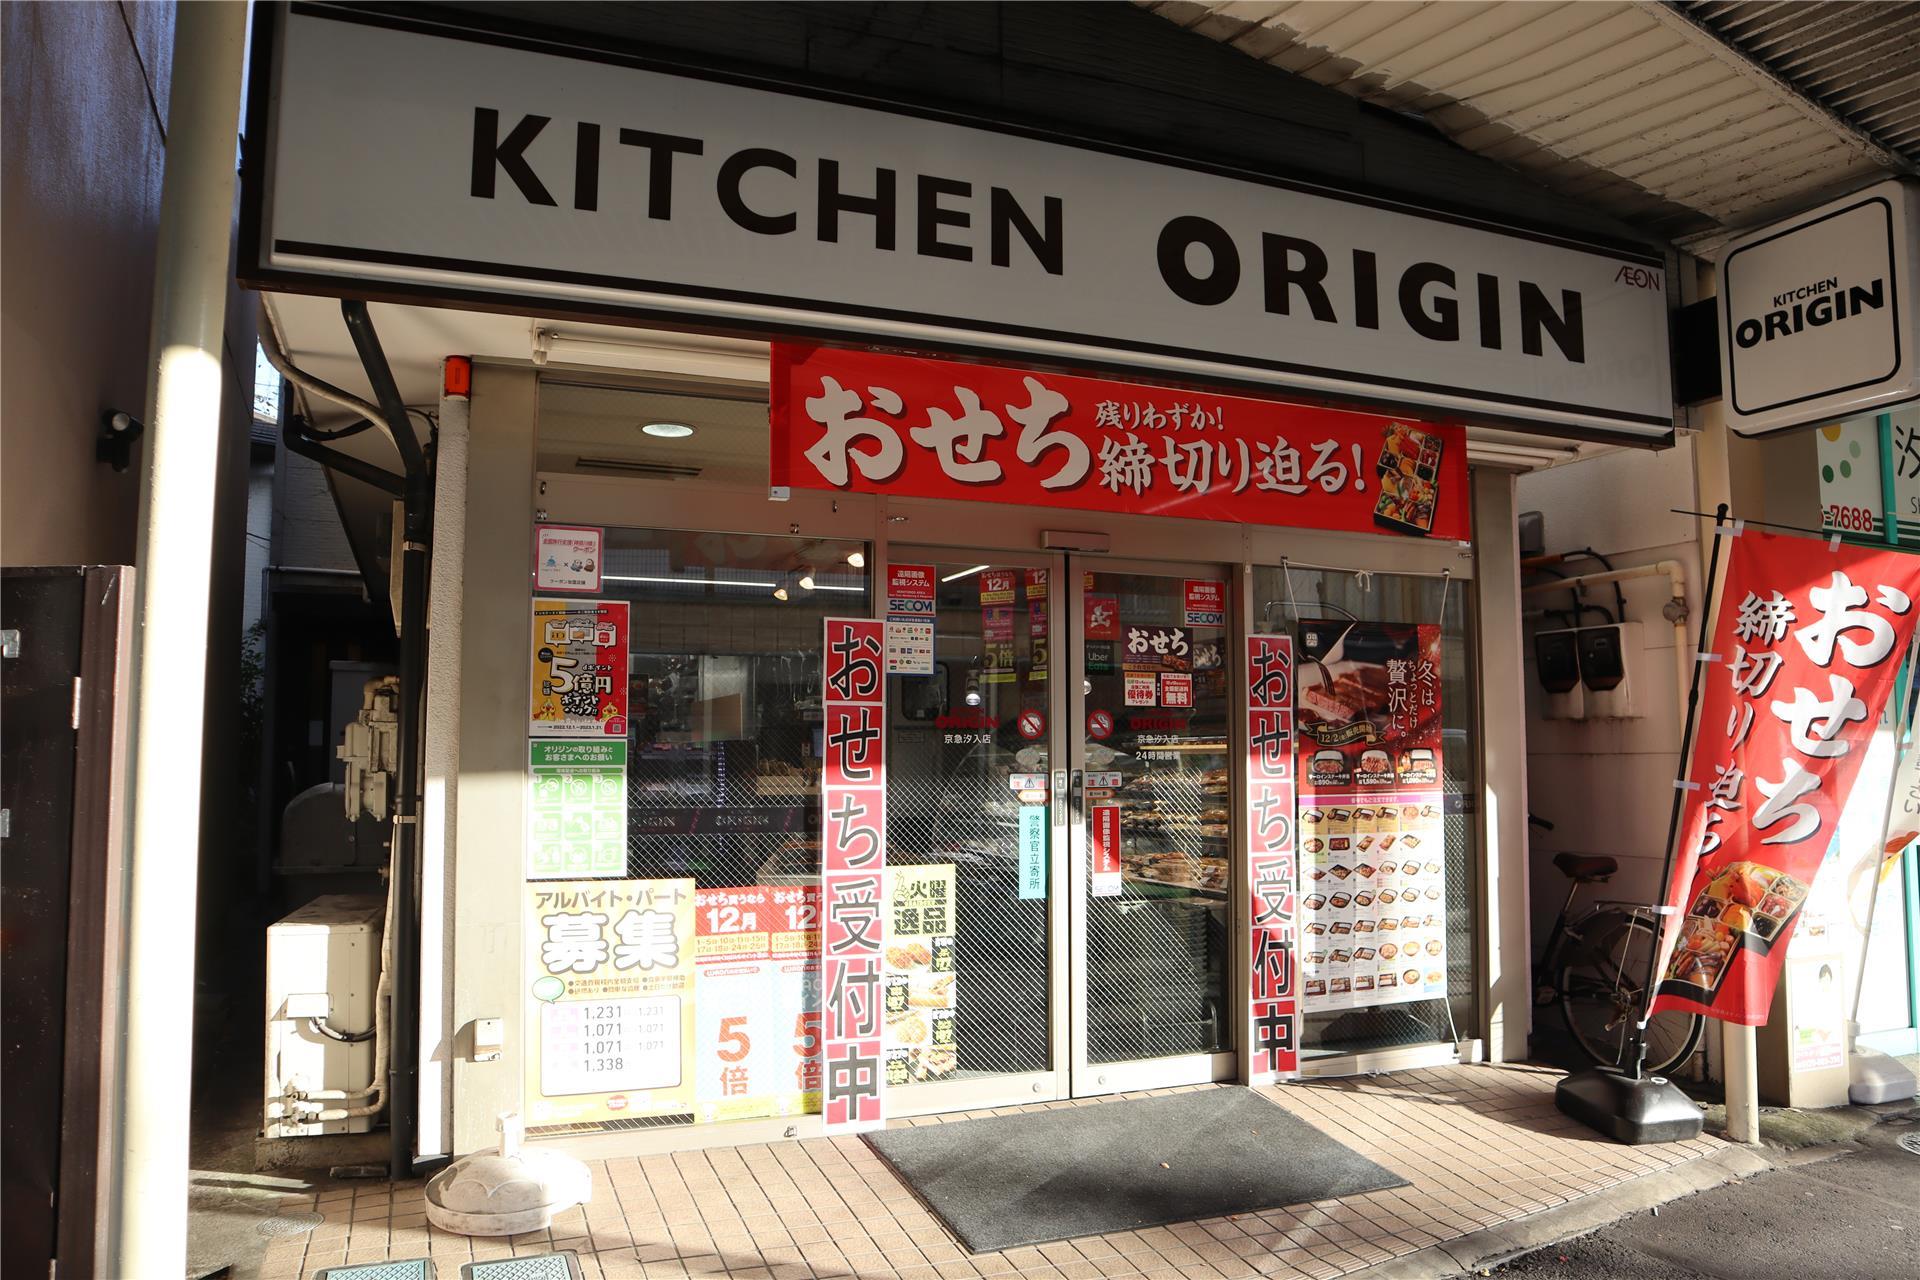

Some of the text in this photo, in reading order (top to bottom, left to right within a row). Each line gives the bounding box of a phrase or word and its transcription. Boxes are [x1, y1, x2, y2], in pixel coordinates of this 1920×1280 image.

[471, 107, 1585, 363] KITCHEN ORIGIN
[1773, 277, 1838, 307] KITCHEN
[1735, 279, 1884, 349] ORIGIN
[1095, 401, 1224, 431] 残りわずか!
[804, 376, 1091, 488] おせち
[1098, 433, 1365, 495] 締切り迫る!
[1820, 504, 1873, 533] -7688
[890, 600, 932, 612] SECOM
[1187, 612, 1222, 623] SECOM
[1127, 627, 1189, 656] おせち
[1088, 653, 1109, 661] Uber
[1408, 660, 1419, 729] ちょっとだけ
[1752, 570, 1911, 844] おせち
[944, 734, 991, 744] 京急汐入店
[545, 753, 612, 761] お客さまへのお願い
[1029, 815, 1040, 890] 警察官立寄所
[1252, 641, 1294, 1072] おせち受付中
[827, 625, 883, 1121] おせち受付中
[535, 888, 687, 909] アルバイト・パート
[706, 906, 757, 933] 12月
[541, 908, 680, 975] 募集
